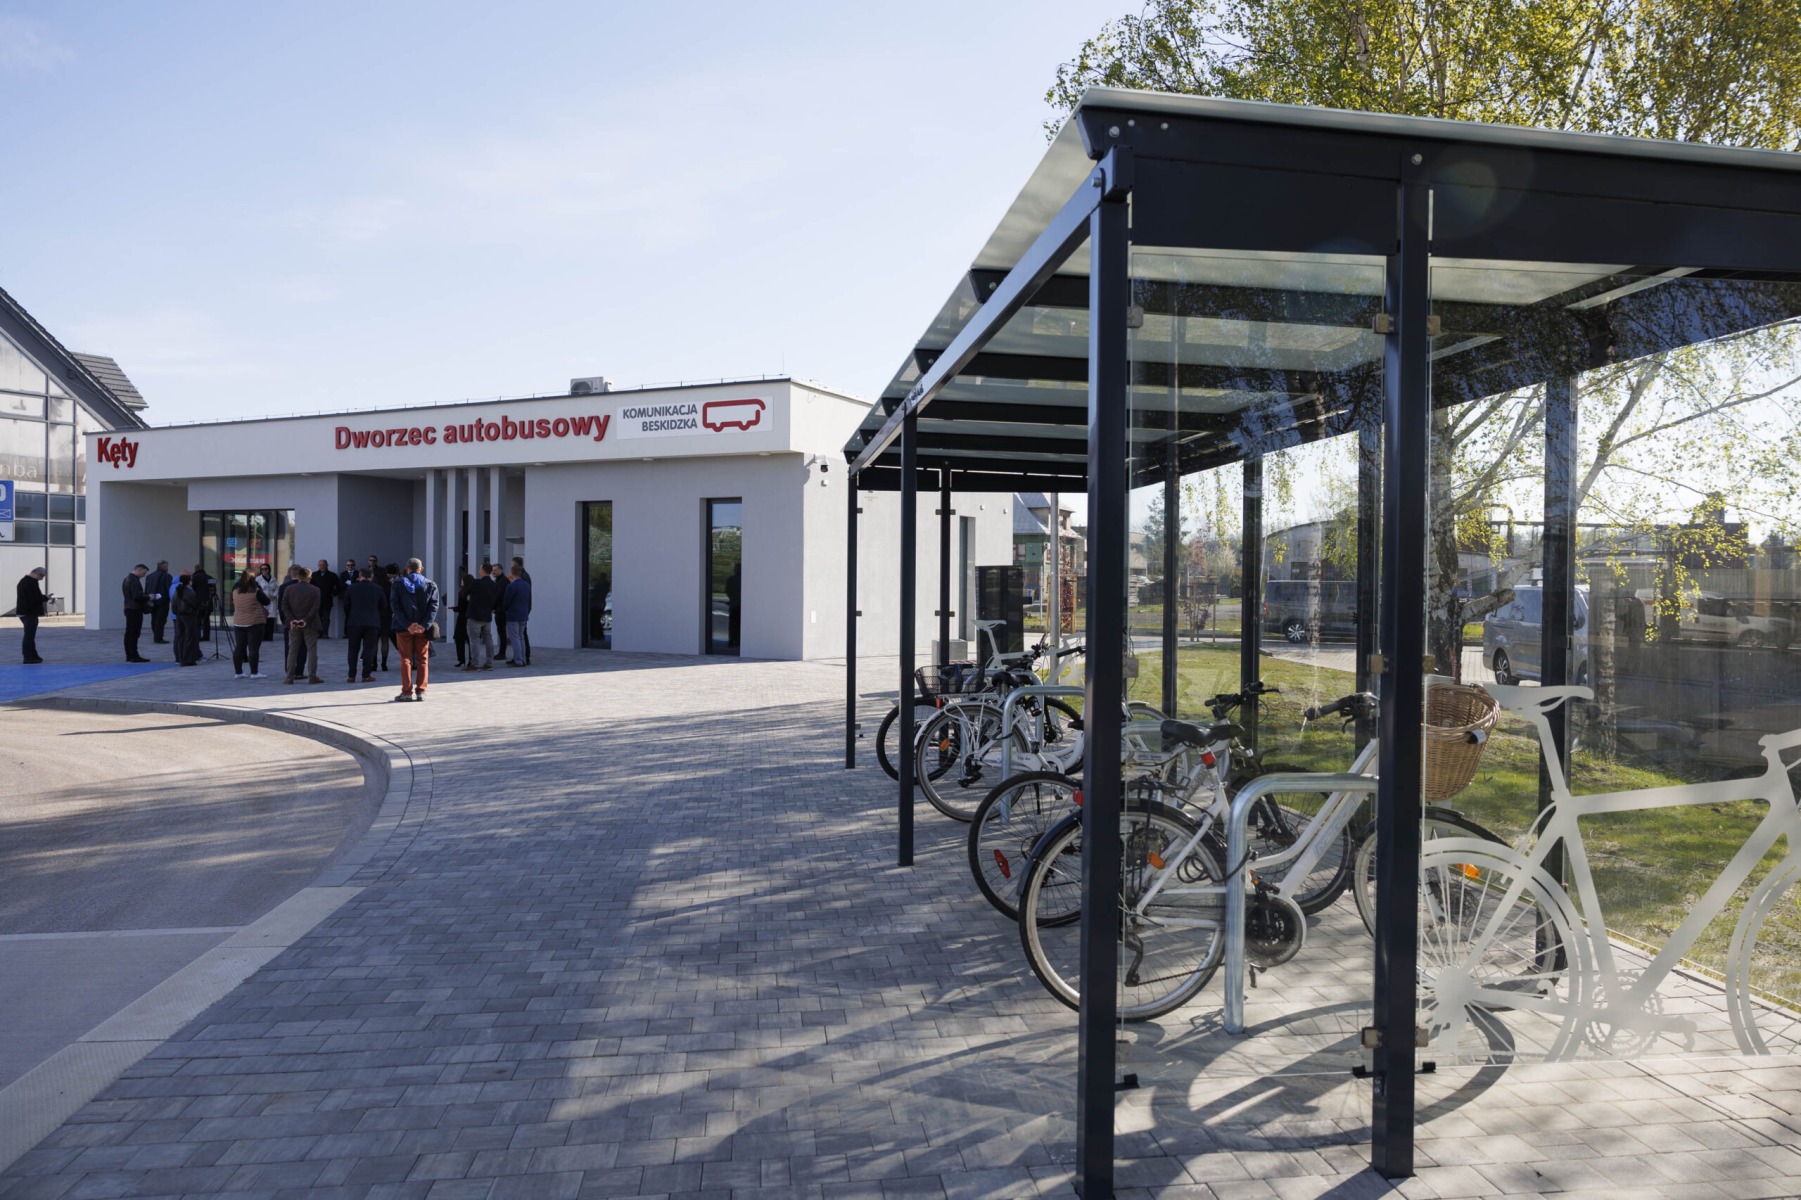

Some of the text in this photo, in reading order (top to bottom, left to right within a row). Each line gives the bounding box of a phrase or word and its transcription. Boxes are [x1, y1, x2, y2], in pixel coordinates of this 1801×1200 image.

[623, 404, 698, 419] KOMUNIKACJA
[335, 414, 611, 450] Dworzec autobusowy
[642, 418, 698, 431] BESKIDZKA
[97, 437, 139, 469] Kęty
